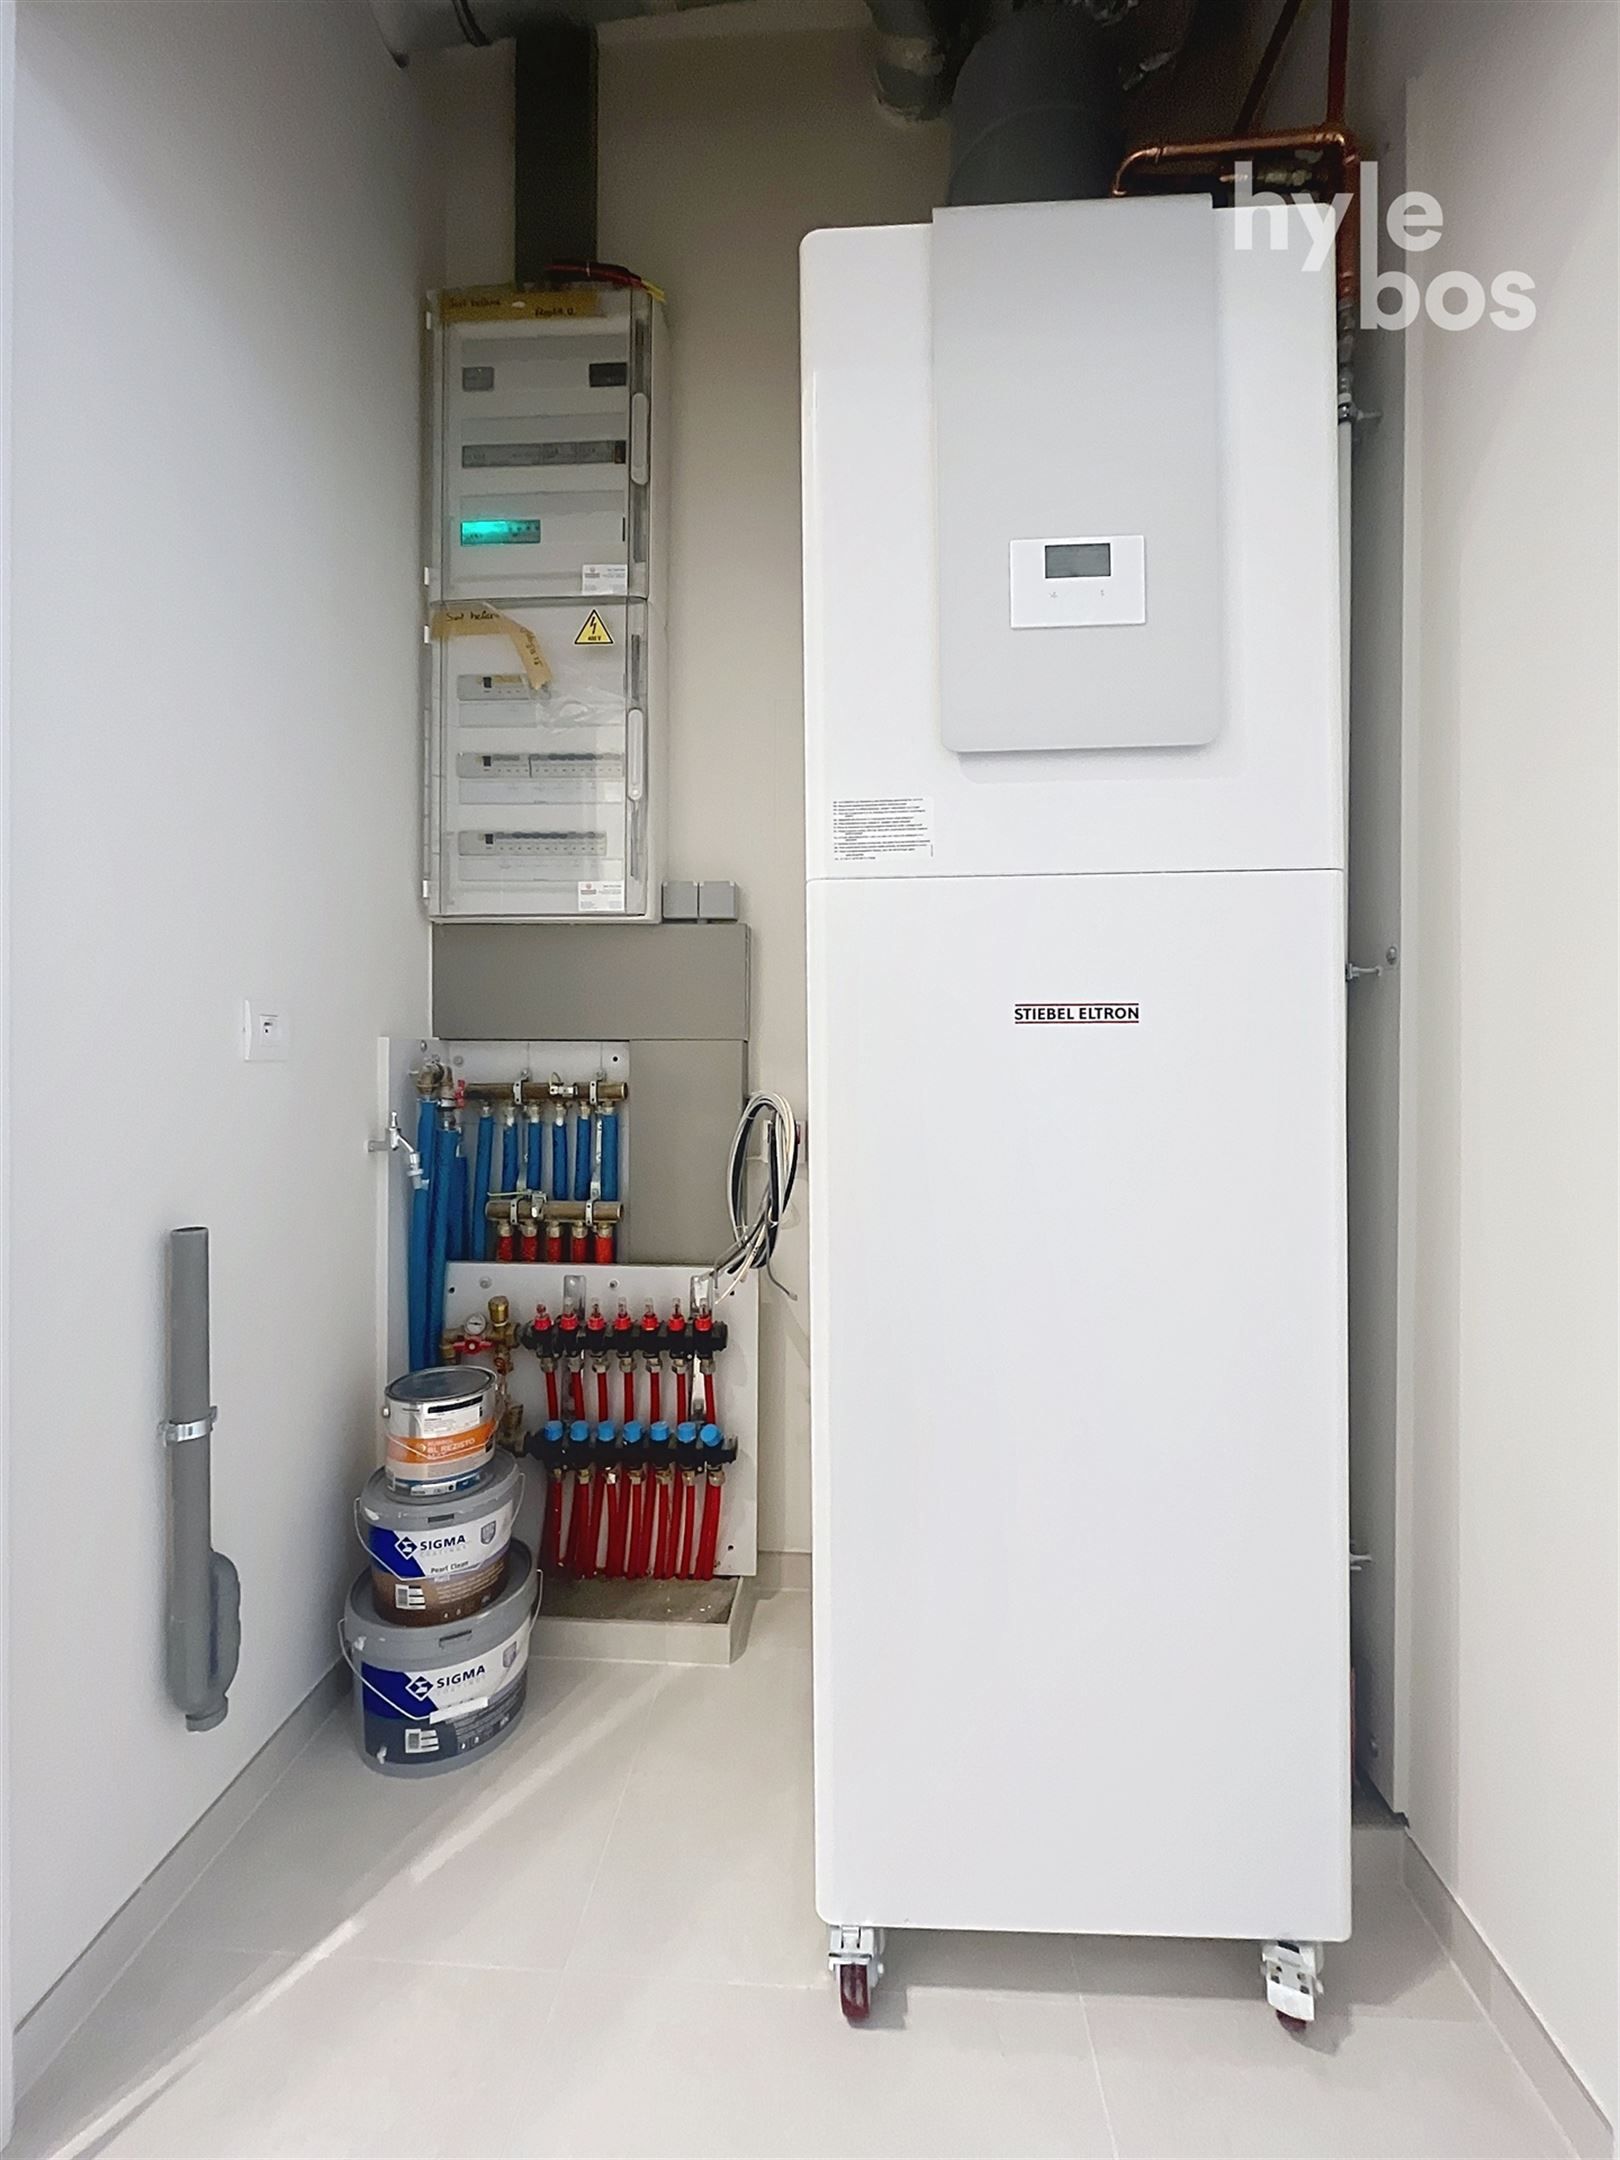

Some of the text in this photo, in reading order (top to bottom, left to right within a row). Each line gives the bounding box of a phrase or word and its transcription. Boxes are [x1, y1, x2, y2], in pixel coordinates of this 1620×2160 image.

[1014, 1007, 1140, 1020] STIEBEL ELTRON
[420, 1534, 466, 1551] SIGMA
[436, 1664, 486, 1689] SIGMA
